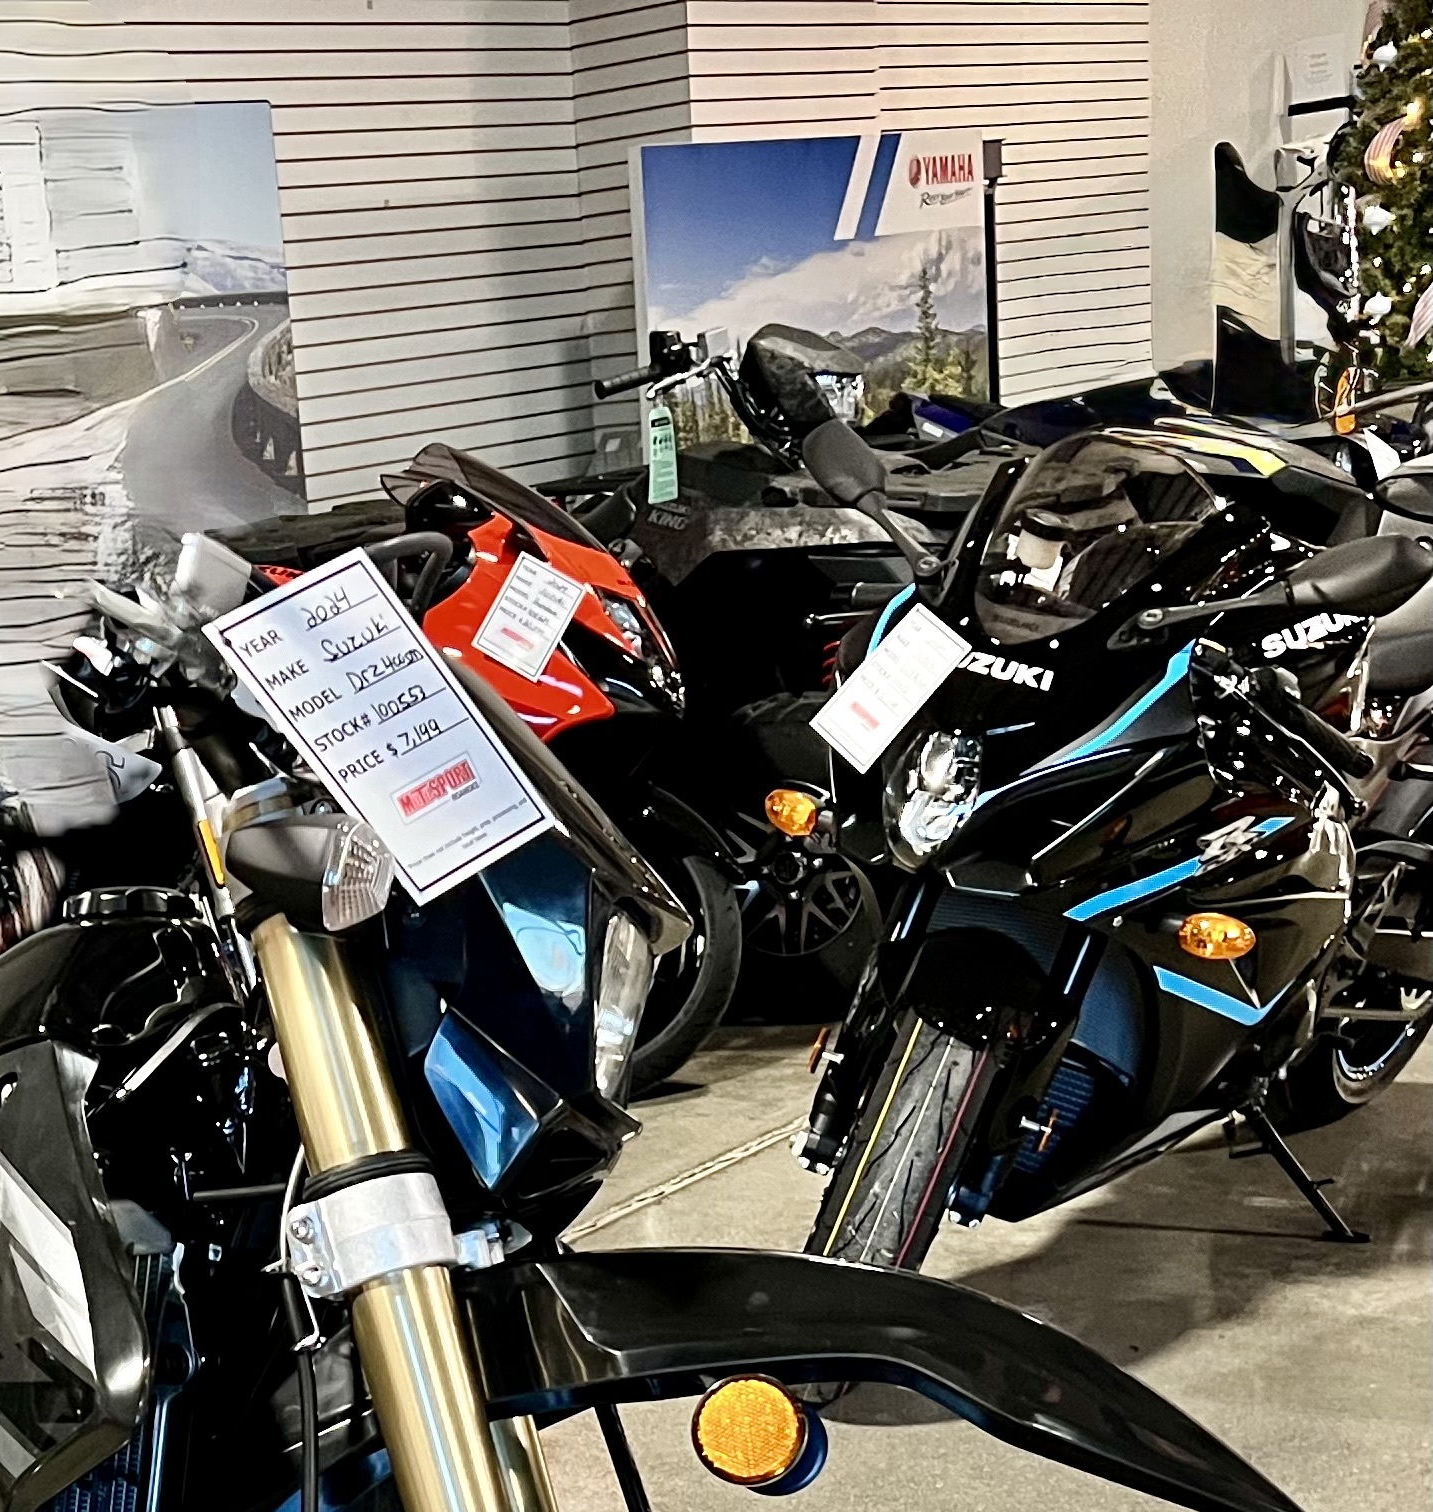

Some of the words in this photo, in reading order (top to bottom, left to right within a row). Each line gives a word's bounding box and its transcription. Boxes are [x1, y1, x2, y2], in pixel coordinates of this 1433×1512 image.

[923, 153, 974, 185] YAMAHA
[239, 629, 283, 658] YEAR
[300, 586, 351, 630] 2024
[264, 659, 310, 691] MAKE
[321, 614, 389, 663] Suzuki
[957, 651, 1055, 691] ZUKI
[289, 687, 343, 722] MODEL
[314, 713, 372, 752] STOCK#
[370, 685, 427, 722] 100553
[338, 749, 385, 783] PRICE
[386, 742, 399, 759] $
[397, 718, 443, 749] 7,199
